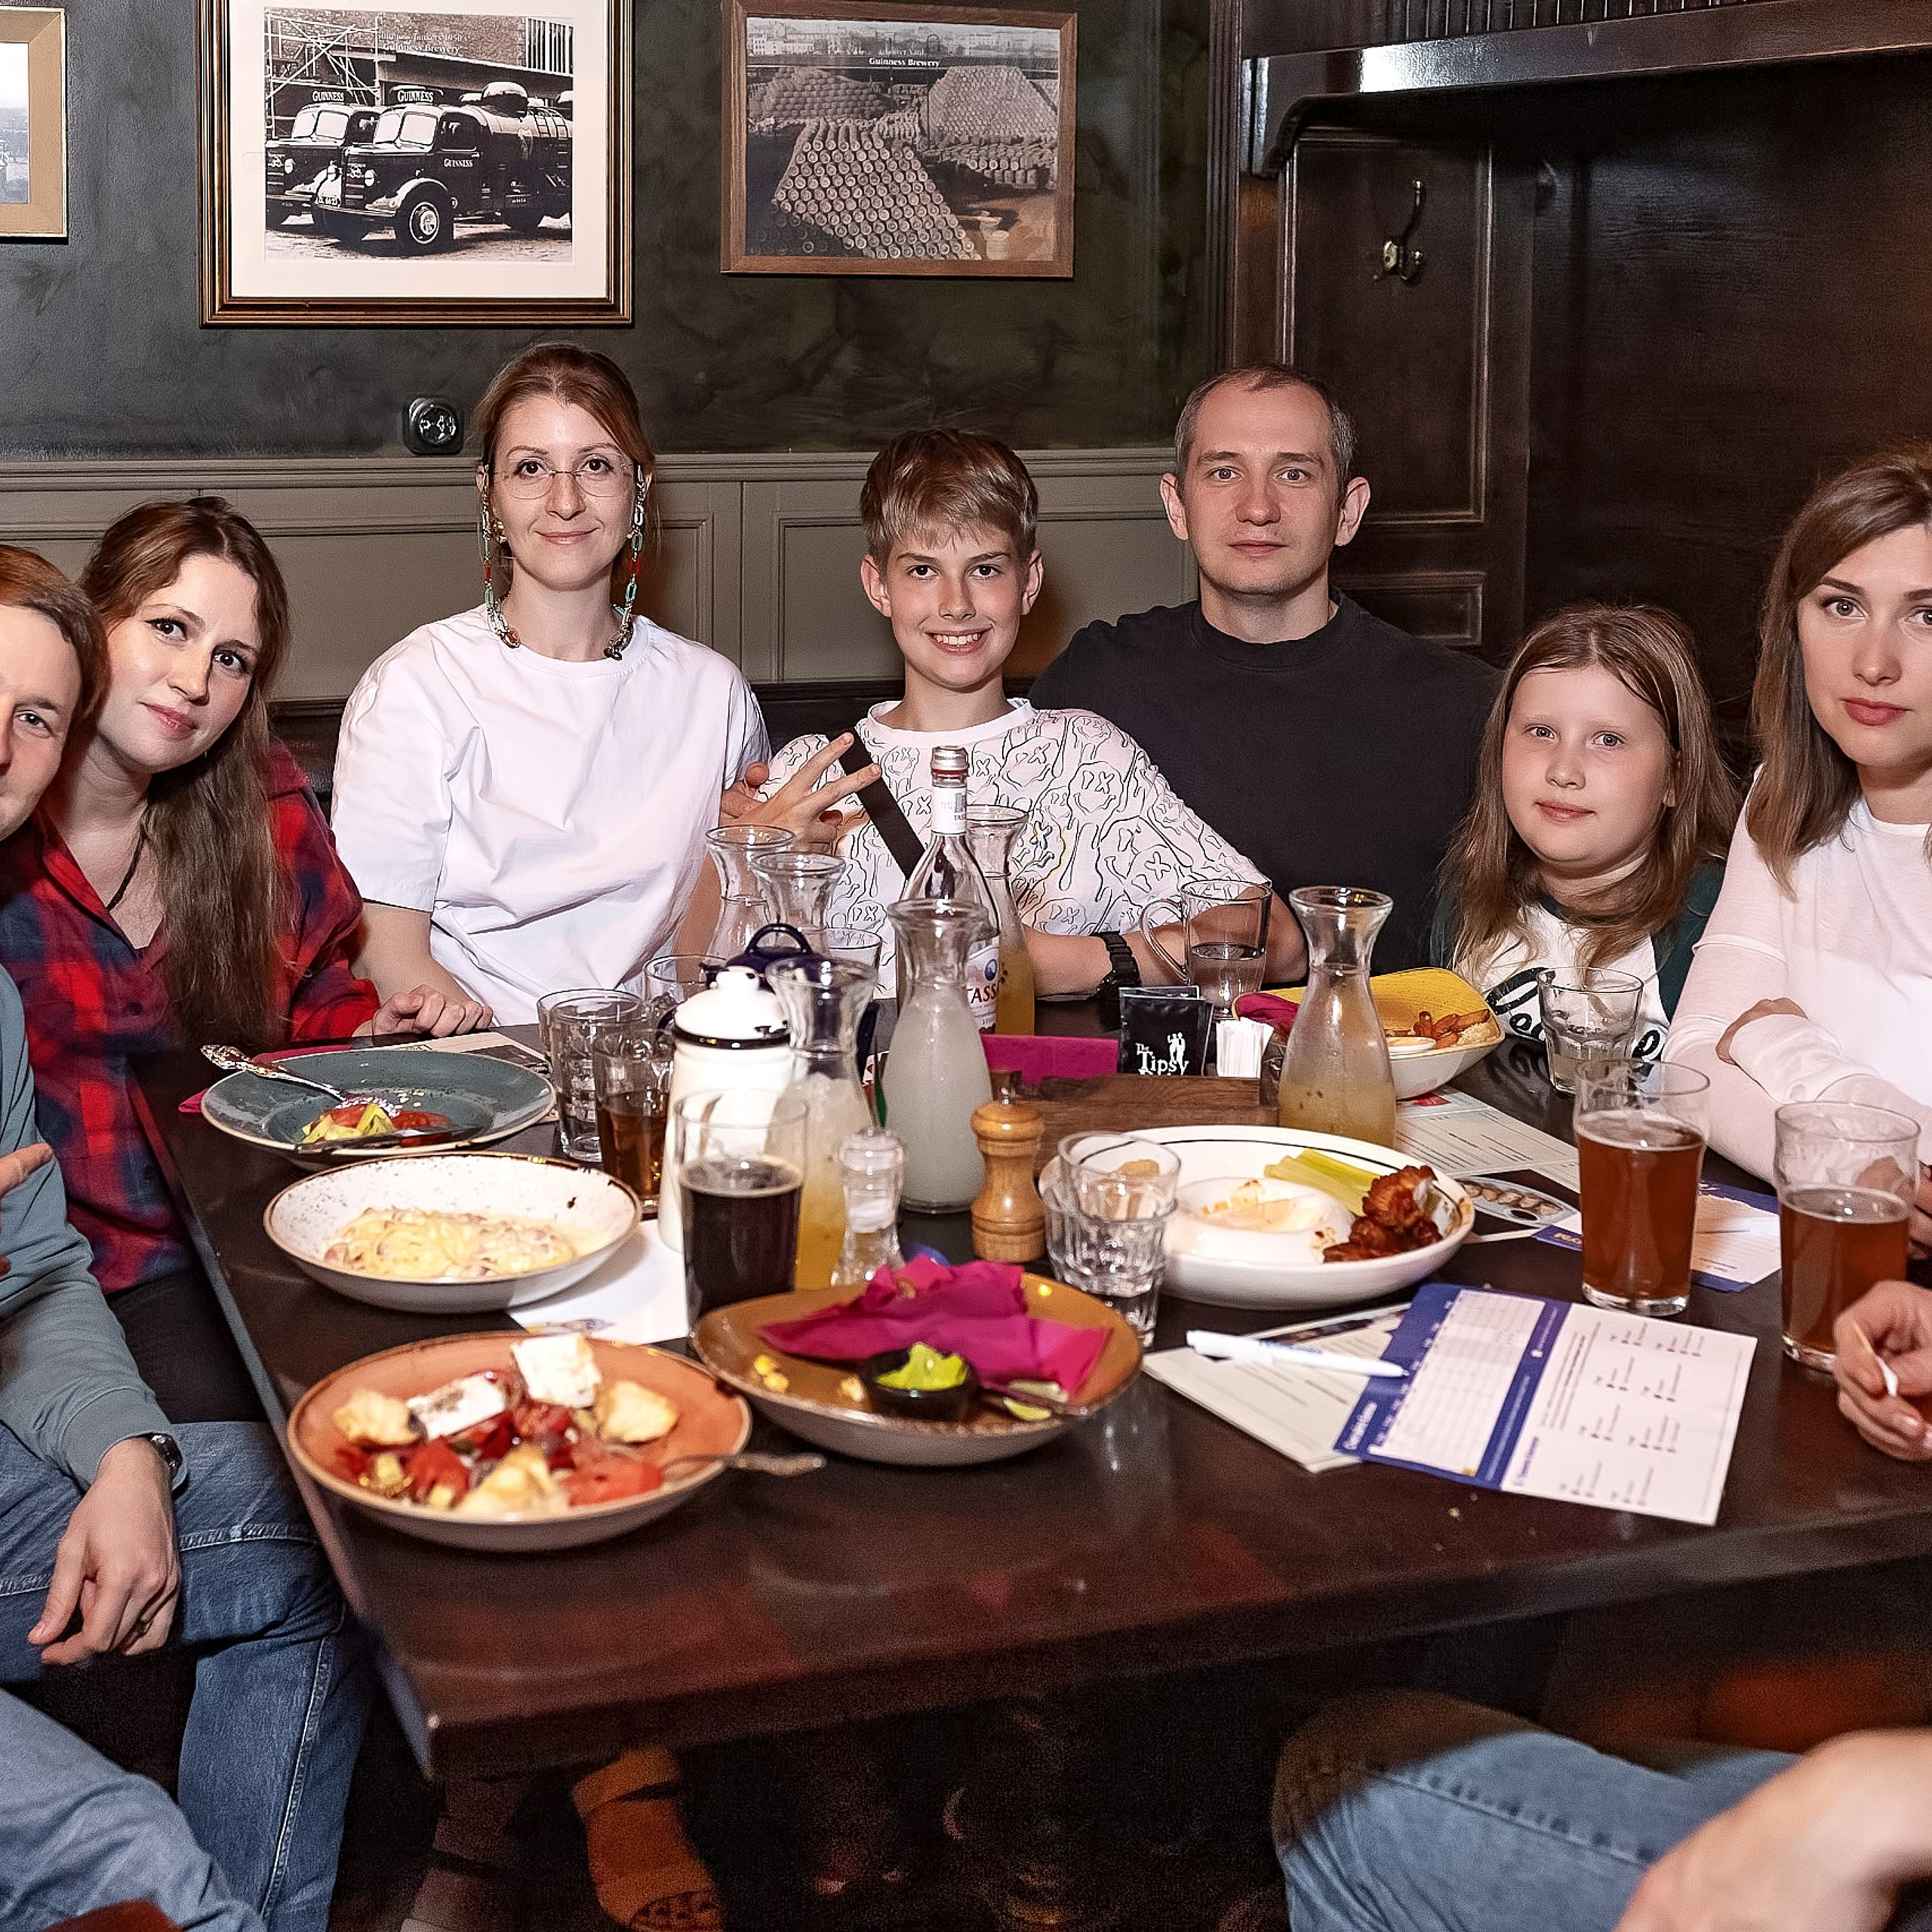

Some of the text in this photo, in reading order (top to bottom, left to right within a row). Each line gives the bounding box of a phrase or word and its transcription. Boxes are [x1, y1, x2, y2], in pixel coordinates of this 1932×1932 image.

[425, 45, 460, 55] Brewery
[869, 57, 941, 68] Guinness Brewery
[312, 91, 344, 102] GUINNESS
[397, 90, 434, 102] GUINNESS
[444, 158, 473, 168] GUINNESS
[1137, 1051, 1189, 1075] Tipsy
